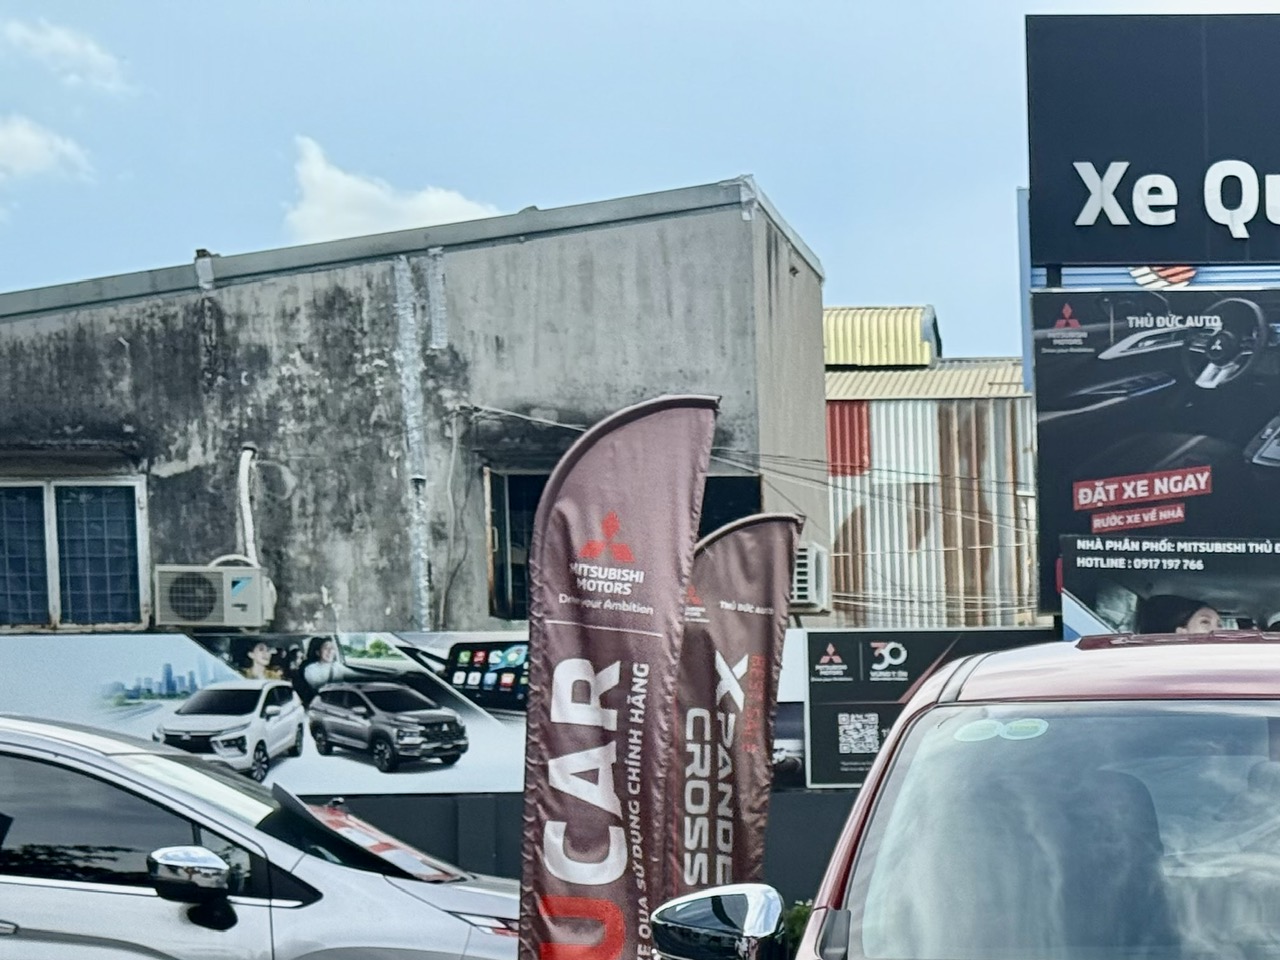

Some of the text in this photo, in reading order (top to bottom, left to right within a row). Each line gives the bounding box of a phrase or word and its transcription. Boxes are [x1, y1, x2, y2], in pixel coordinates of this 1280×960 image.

[1073, 160, 1178, 227] Xe
[1127, 313, 1222, 328] THỦ ĐỨC AUTO
[1078, 471, 1210, 507] ĐẶT XE NGAY
[1126, 515, 1141, 525] XE
[1142, 511, 1158, 522] VỀ
[1159, 508, 1184, 520] NHÀ
[1076, 539, 1104, 550] NHÀ
[1105, 539, 1140, 551] PHÂN
[1176, 542, 1246, 553] MITSUBISHI
[1247, 539, 1272, 553] THỦ
[1076, 557, 1126, 569] HOTLINE
[1133, 560, 1160, 569] 0917
[1161, 560, 1181, 569] 197
[1182, 560, 1205, 570] 766
[576, 578, 633, 595] MOTORS
[603, 599, 653, 615] Ambition
[626, 662, 650, 725] HÃNG
[624, 728, 644, 797] CHÍNH
[715, 650, 749, 885] XPANDE
[684, 708, 711, 886] CROSS
[637, 896, 650, 939] QUA
